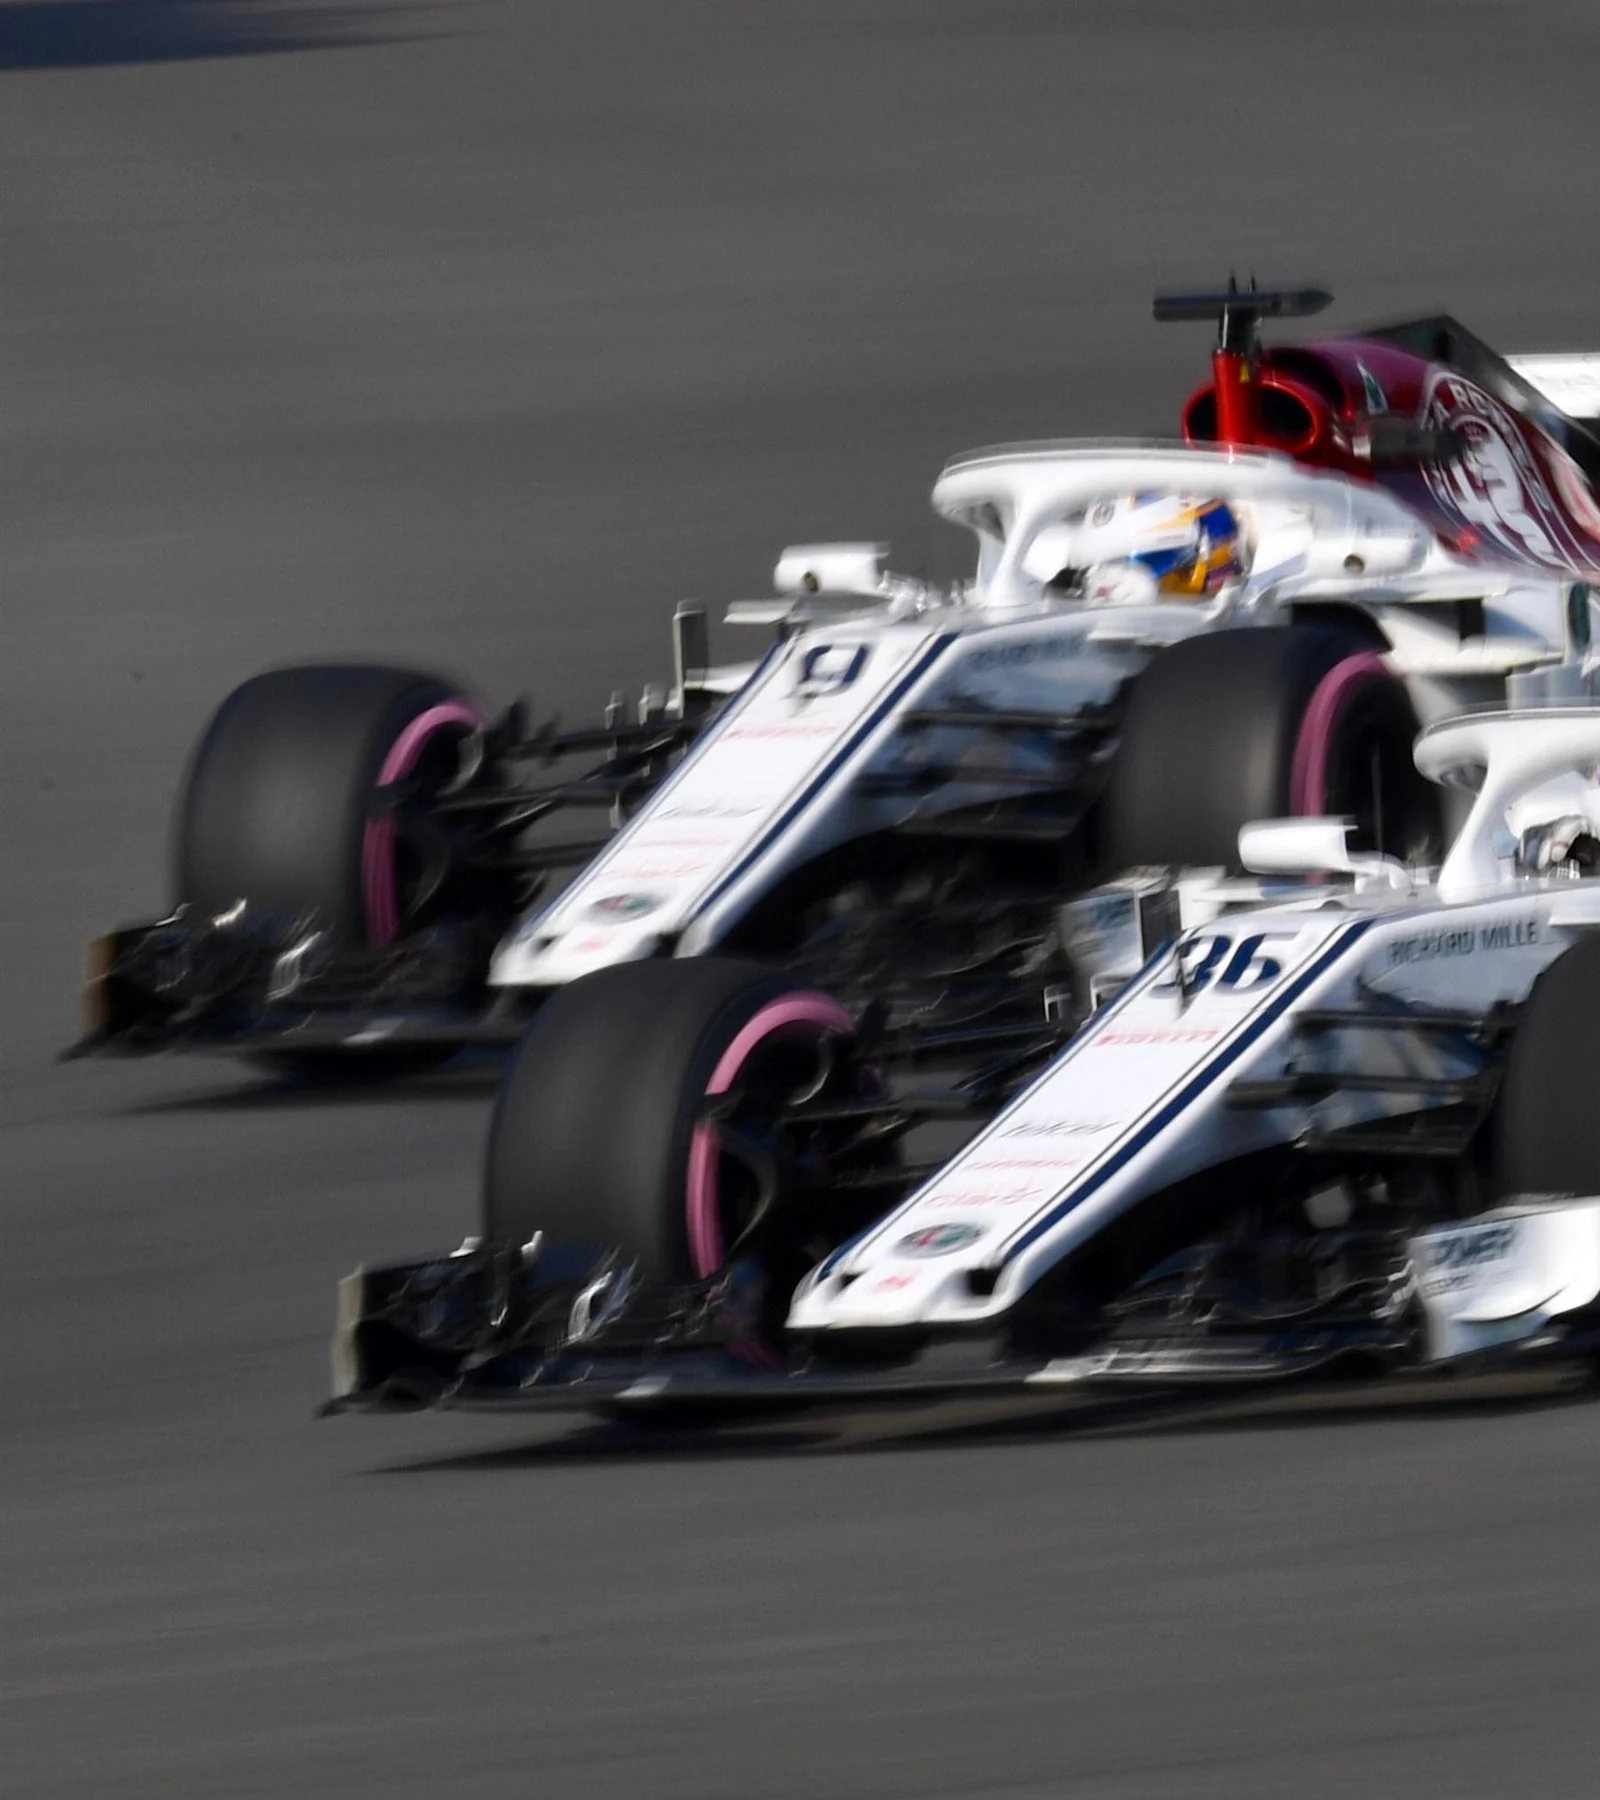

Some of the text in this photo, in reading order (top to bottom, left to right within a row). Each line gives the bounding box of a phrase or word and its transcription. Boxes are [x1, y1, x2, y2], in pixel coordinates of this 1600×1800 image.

[797, 643, 870, 700] 9
[1480, 919, 1539, 951] MILLE
[1150, 933, 1292, 995] 36
